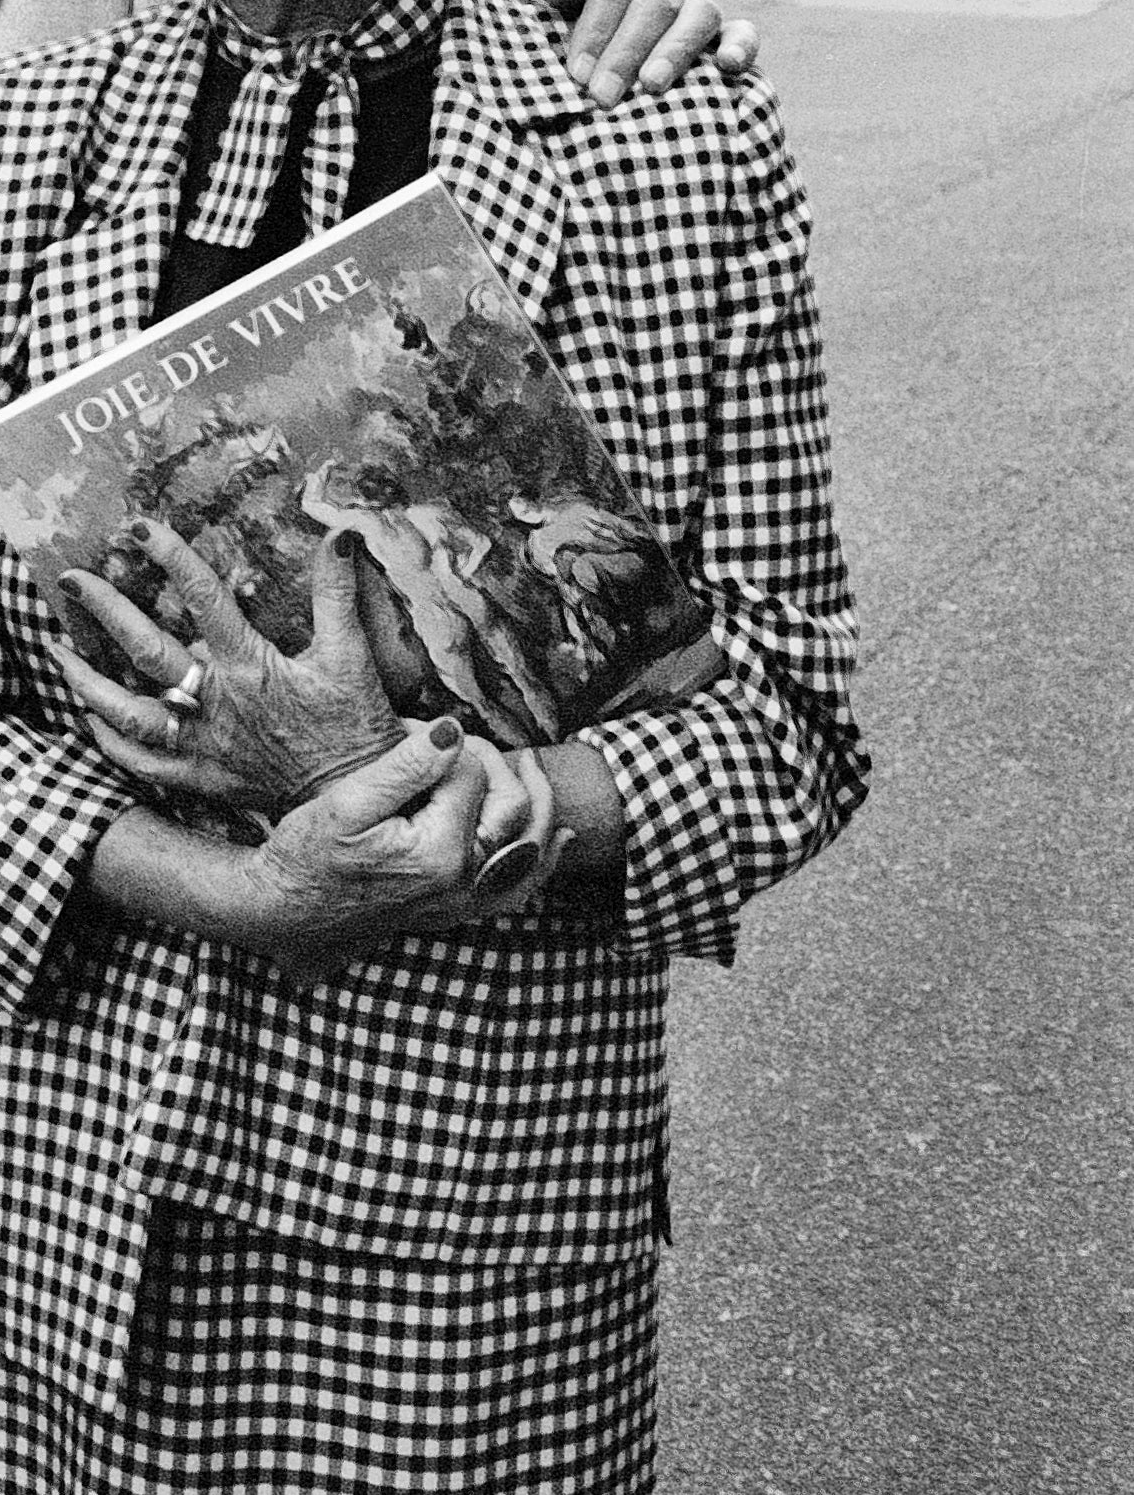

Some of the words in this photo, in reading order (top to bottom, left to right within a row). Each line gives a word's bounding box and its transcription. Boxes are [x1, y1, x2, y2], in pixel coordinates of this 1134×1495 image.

[56, 371, 159, 455] JOIE
[156, 334, 230, 393] DE
[227, 256, 372, 348] VIVRE
